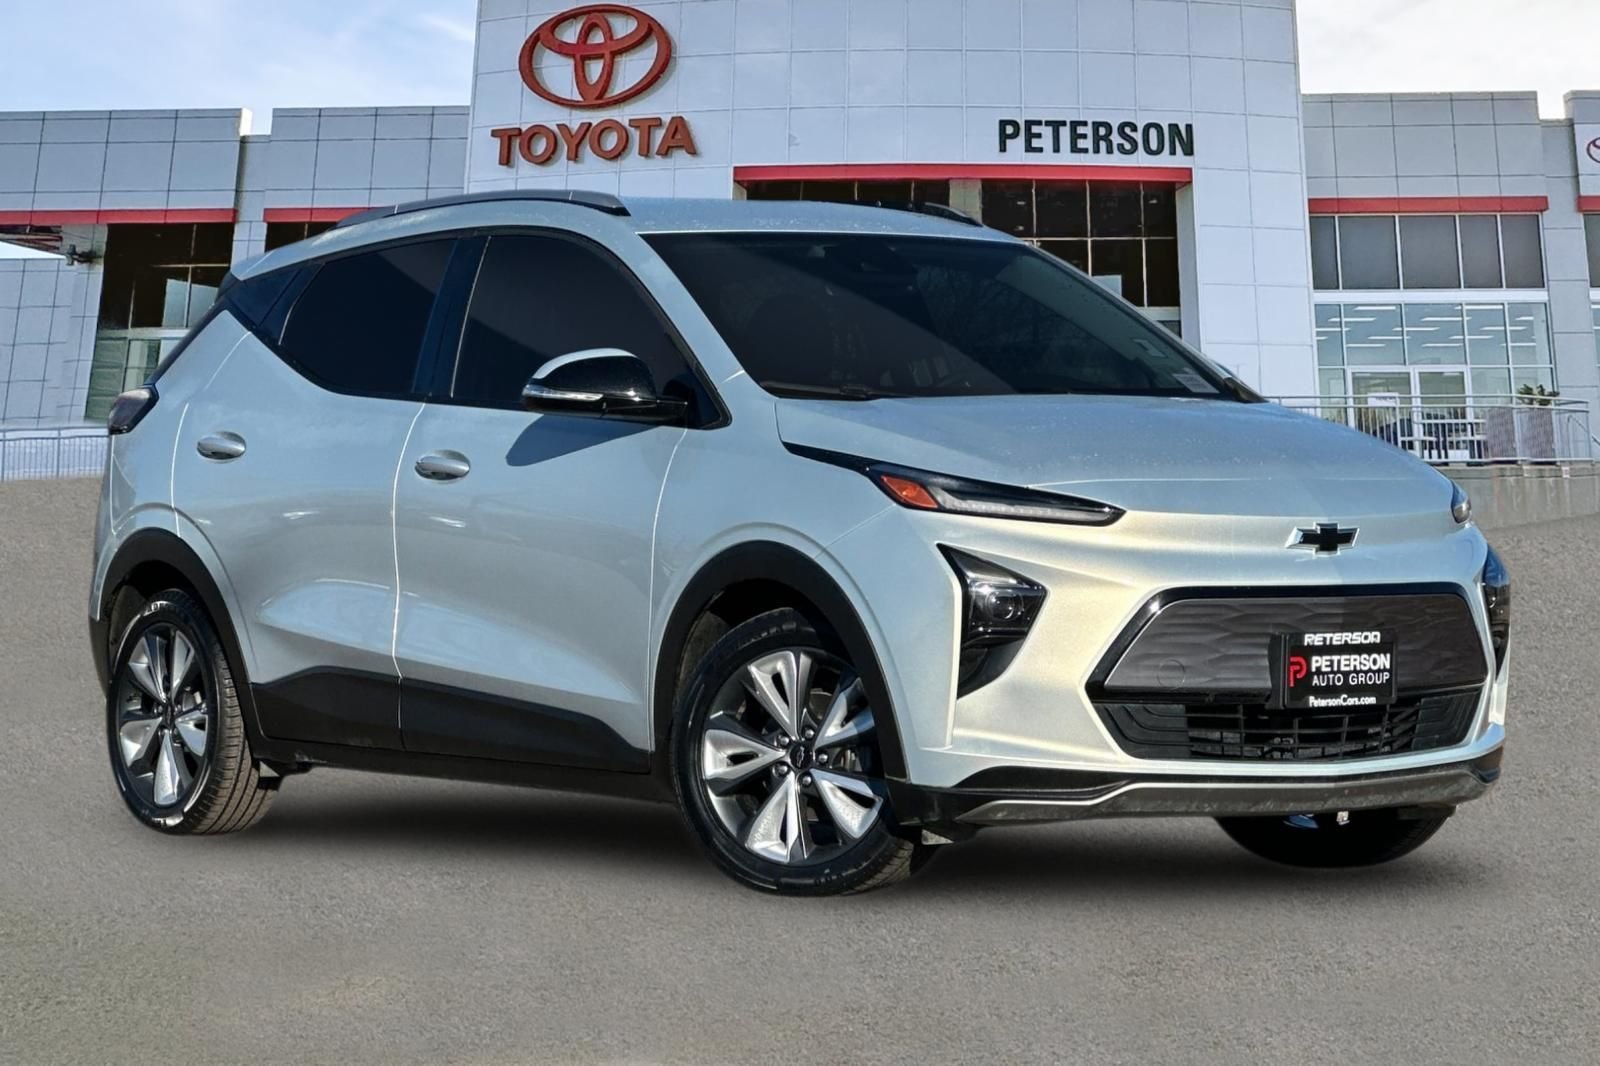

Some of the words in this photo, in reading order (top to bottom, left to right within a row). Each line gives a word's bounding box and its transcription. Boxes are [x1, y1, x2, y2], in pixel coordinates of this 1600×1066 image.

[491, 116, 697, 166] TOYOTA
[998, 119, 1194, 157] PETERSON
[1311, 653, 1391, 671] PETERSON
[1312, 673, 1343, 687] AUTO
[1349, 672, 1390, 686] GROUP
[1309, 694, 1376, 707] PetersonCars.com
